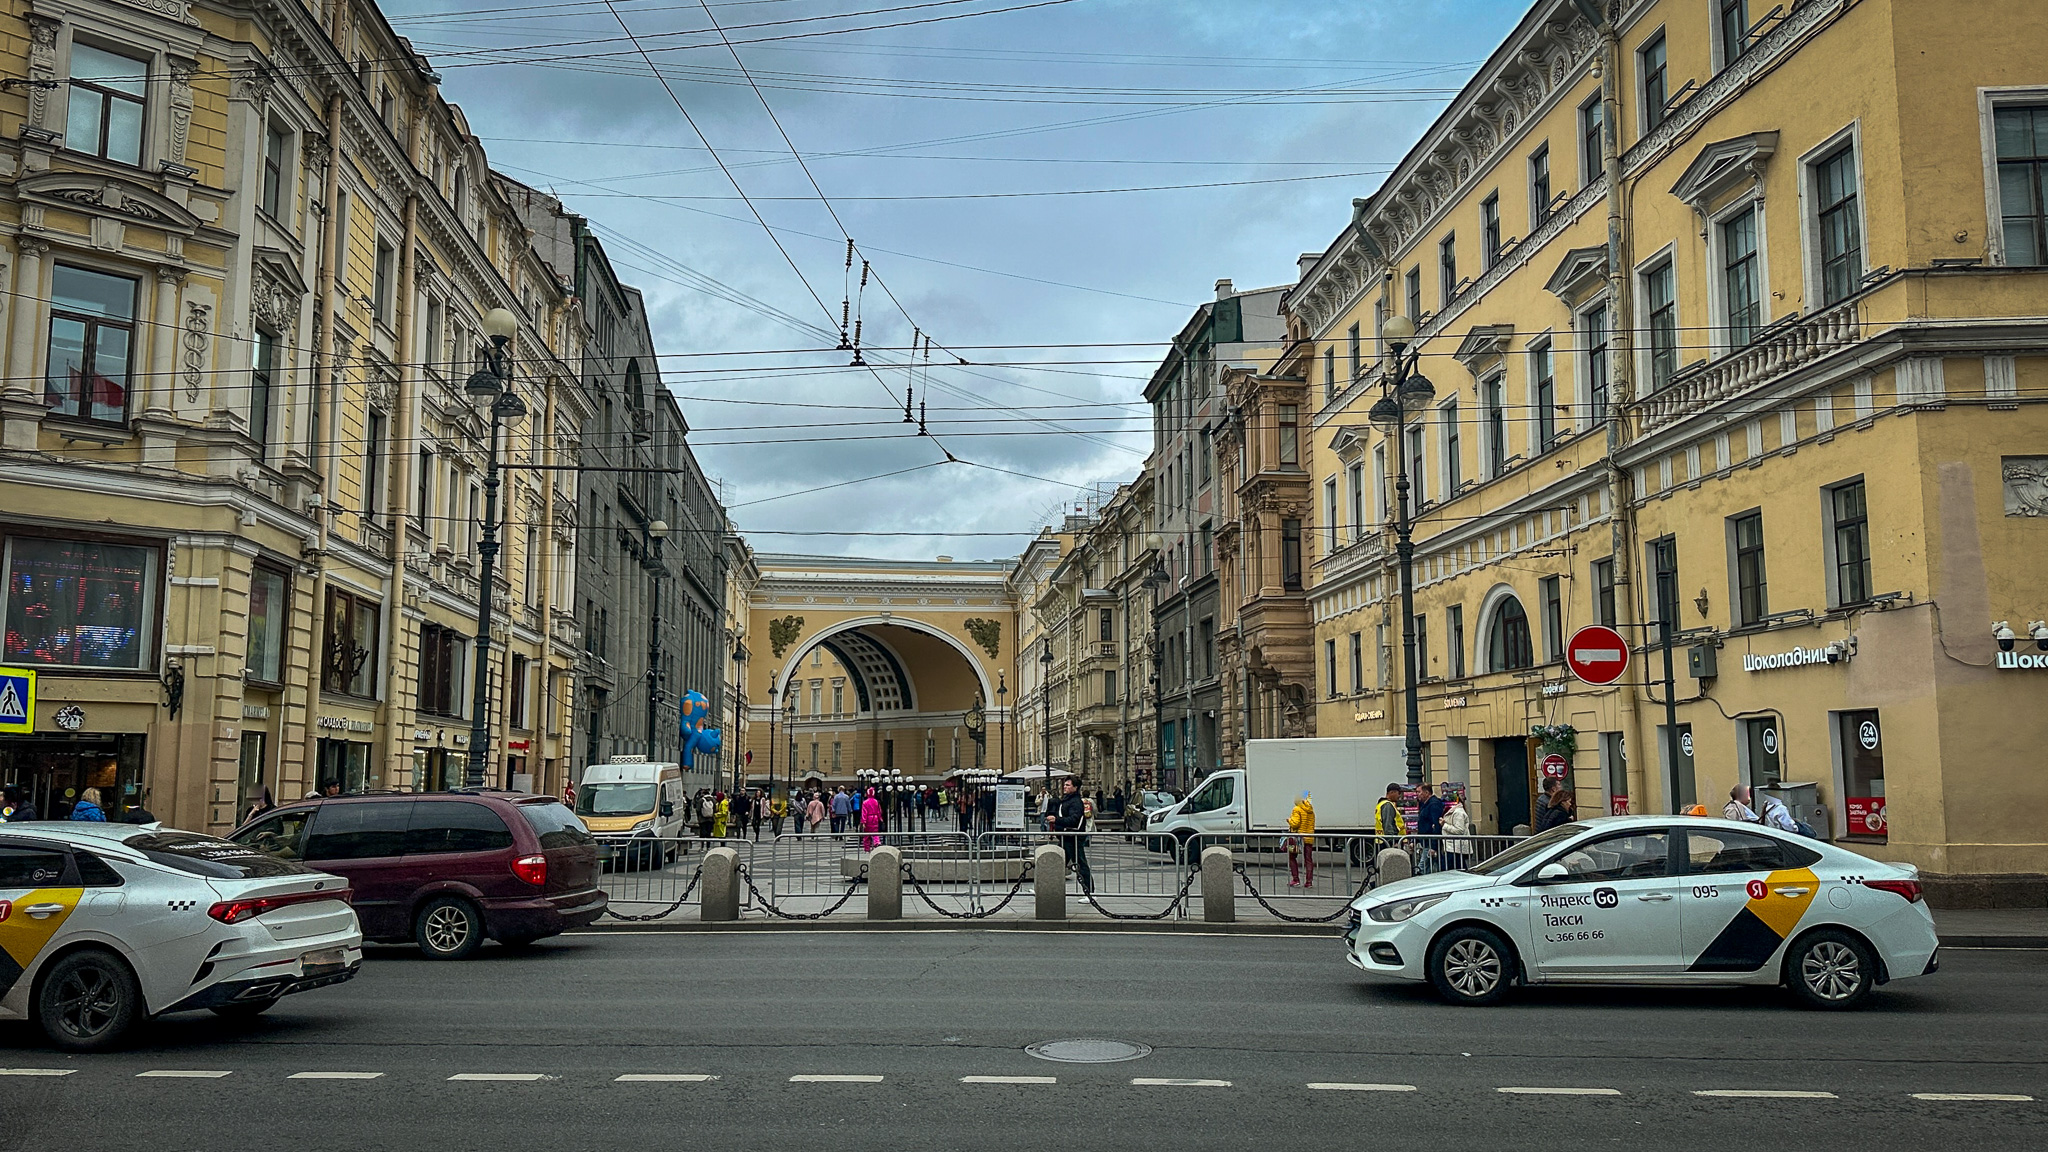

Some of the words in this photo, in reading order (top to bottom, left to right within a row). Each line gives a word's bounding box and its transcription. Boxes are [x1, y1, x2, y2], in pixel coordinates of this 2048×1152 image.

[1743, 646, 1831, 672] Шоколадниц
[1996, 651, 2048, 669] Шок
[1862, 726, 1874, 737] 24
[1683, 736, 1692, 746] 24
[1692, 885, 1719, 899] 095
[1751, 882, 1763, 897] Я
[1540, 894, 1592, 909] Яндекс
[1596, 890, 1617, 905] Go
[1542, 913, 1584, 927] Такси
[1555, 932, 1575, 942] 366
[1577, 931, 1590, 941] 66
[1592, 929, 1605, 940] 66
